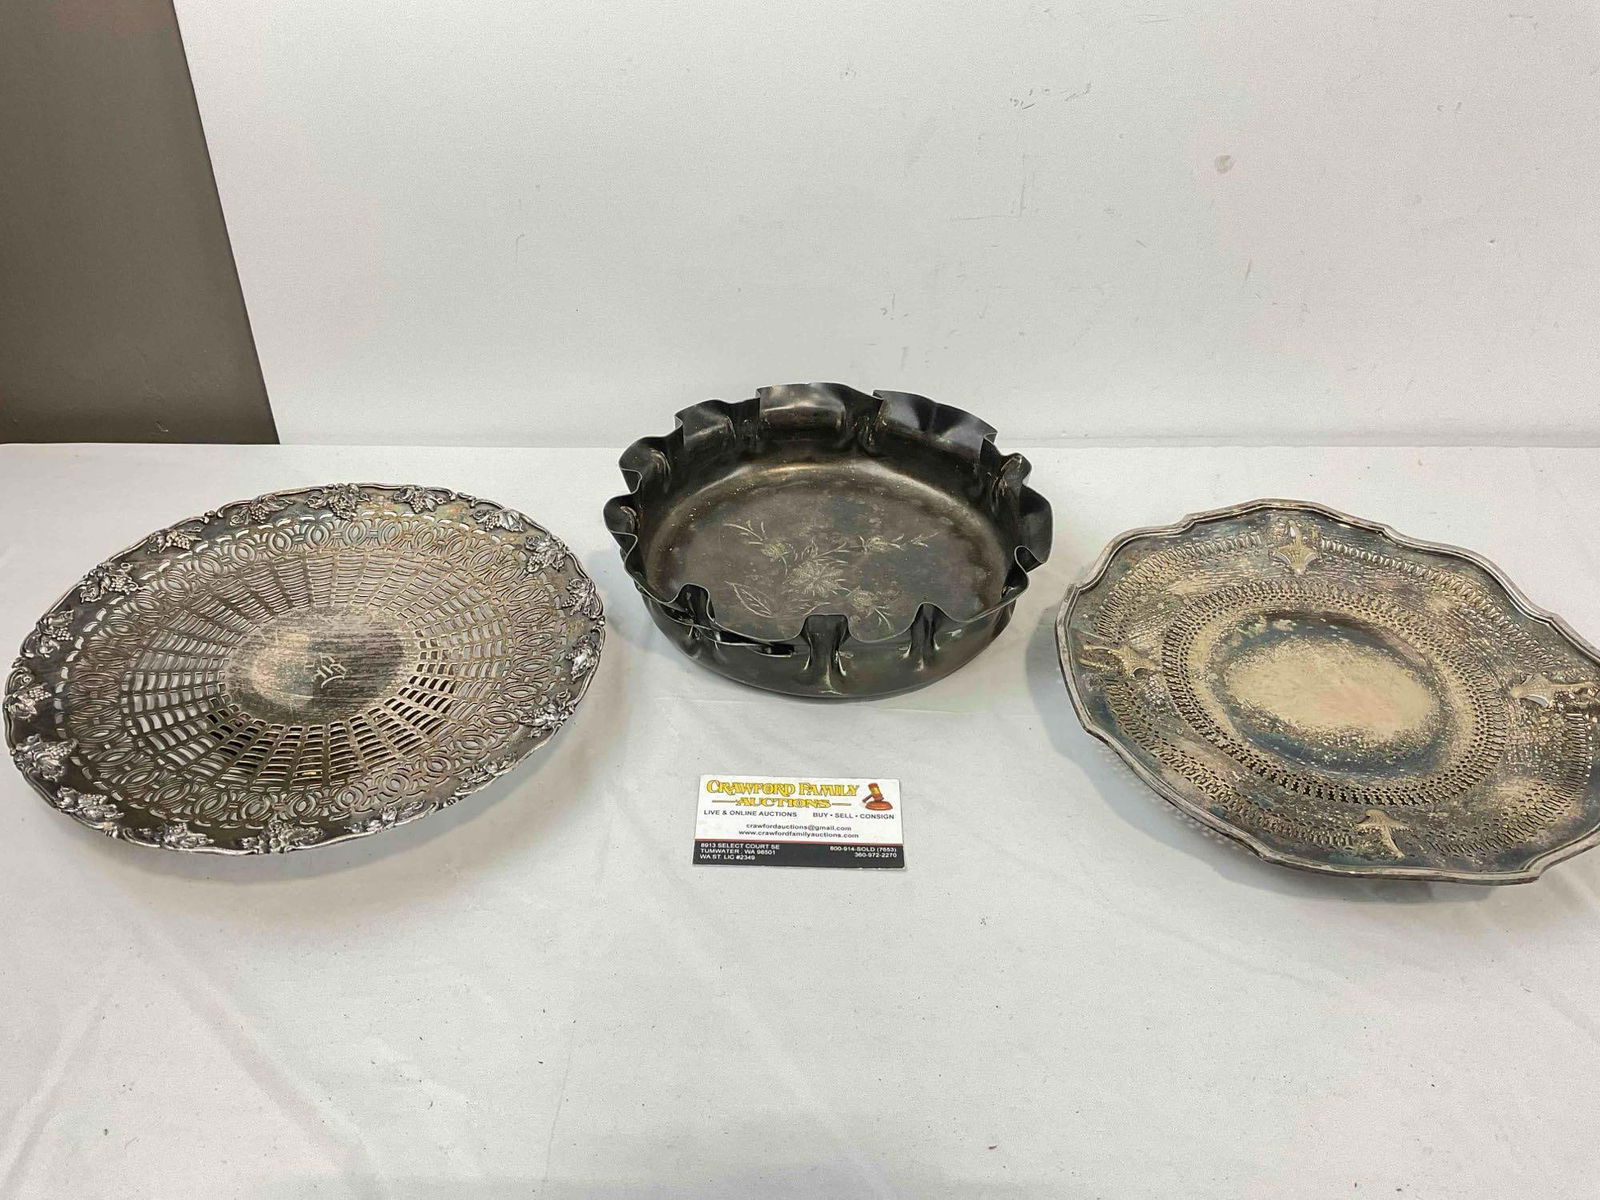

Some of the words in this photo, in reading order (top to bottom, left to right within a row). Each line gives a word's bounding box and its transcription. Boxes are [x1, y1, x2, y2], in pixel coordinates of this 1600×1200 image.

[735, 797, 831, 809] AUCTIONS
[746, 823, 852, 831] crawfordauctions@gmail.com
[738, 831, 859, 839] www.crawfordfamilyauctions.com
